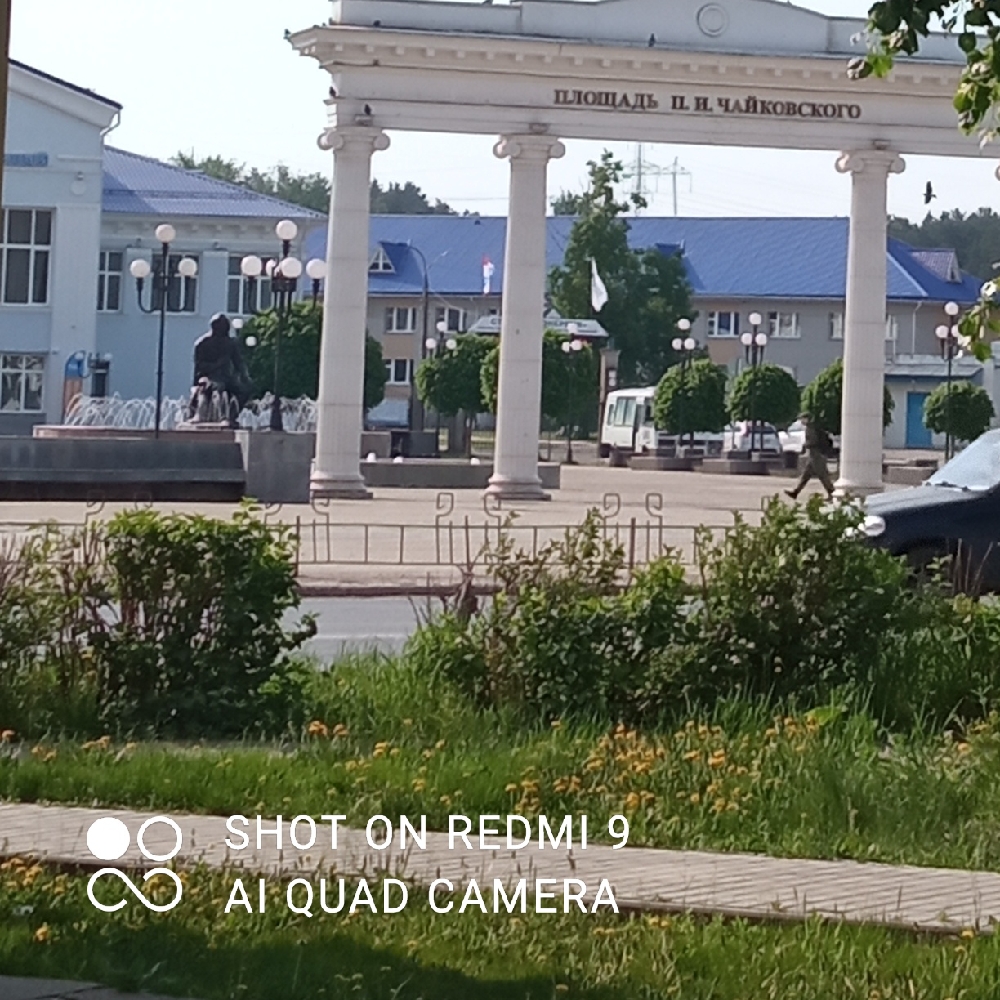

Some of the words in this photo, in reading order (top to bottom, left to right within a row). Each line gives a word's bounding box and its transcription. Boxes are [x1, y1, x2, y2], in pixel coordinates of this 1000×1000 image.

[554, 89, 659, 110] ПЛОЩАДЬ
[671, 95, 690, 110] П.
[717, 96, 861, 119] ЧАЙКОВСКОГО
